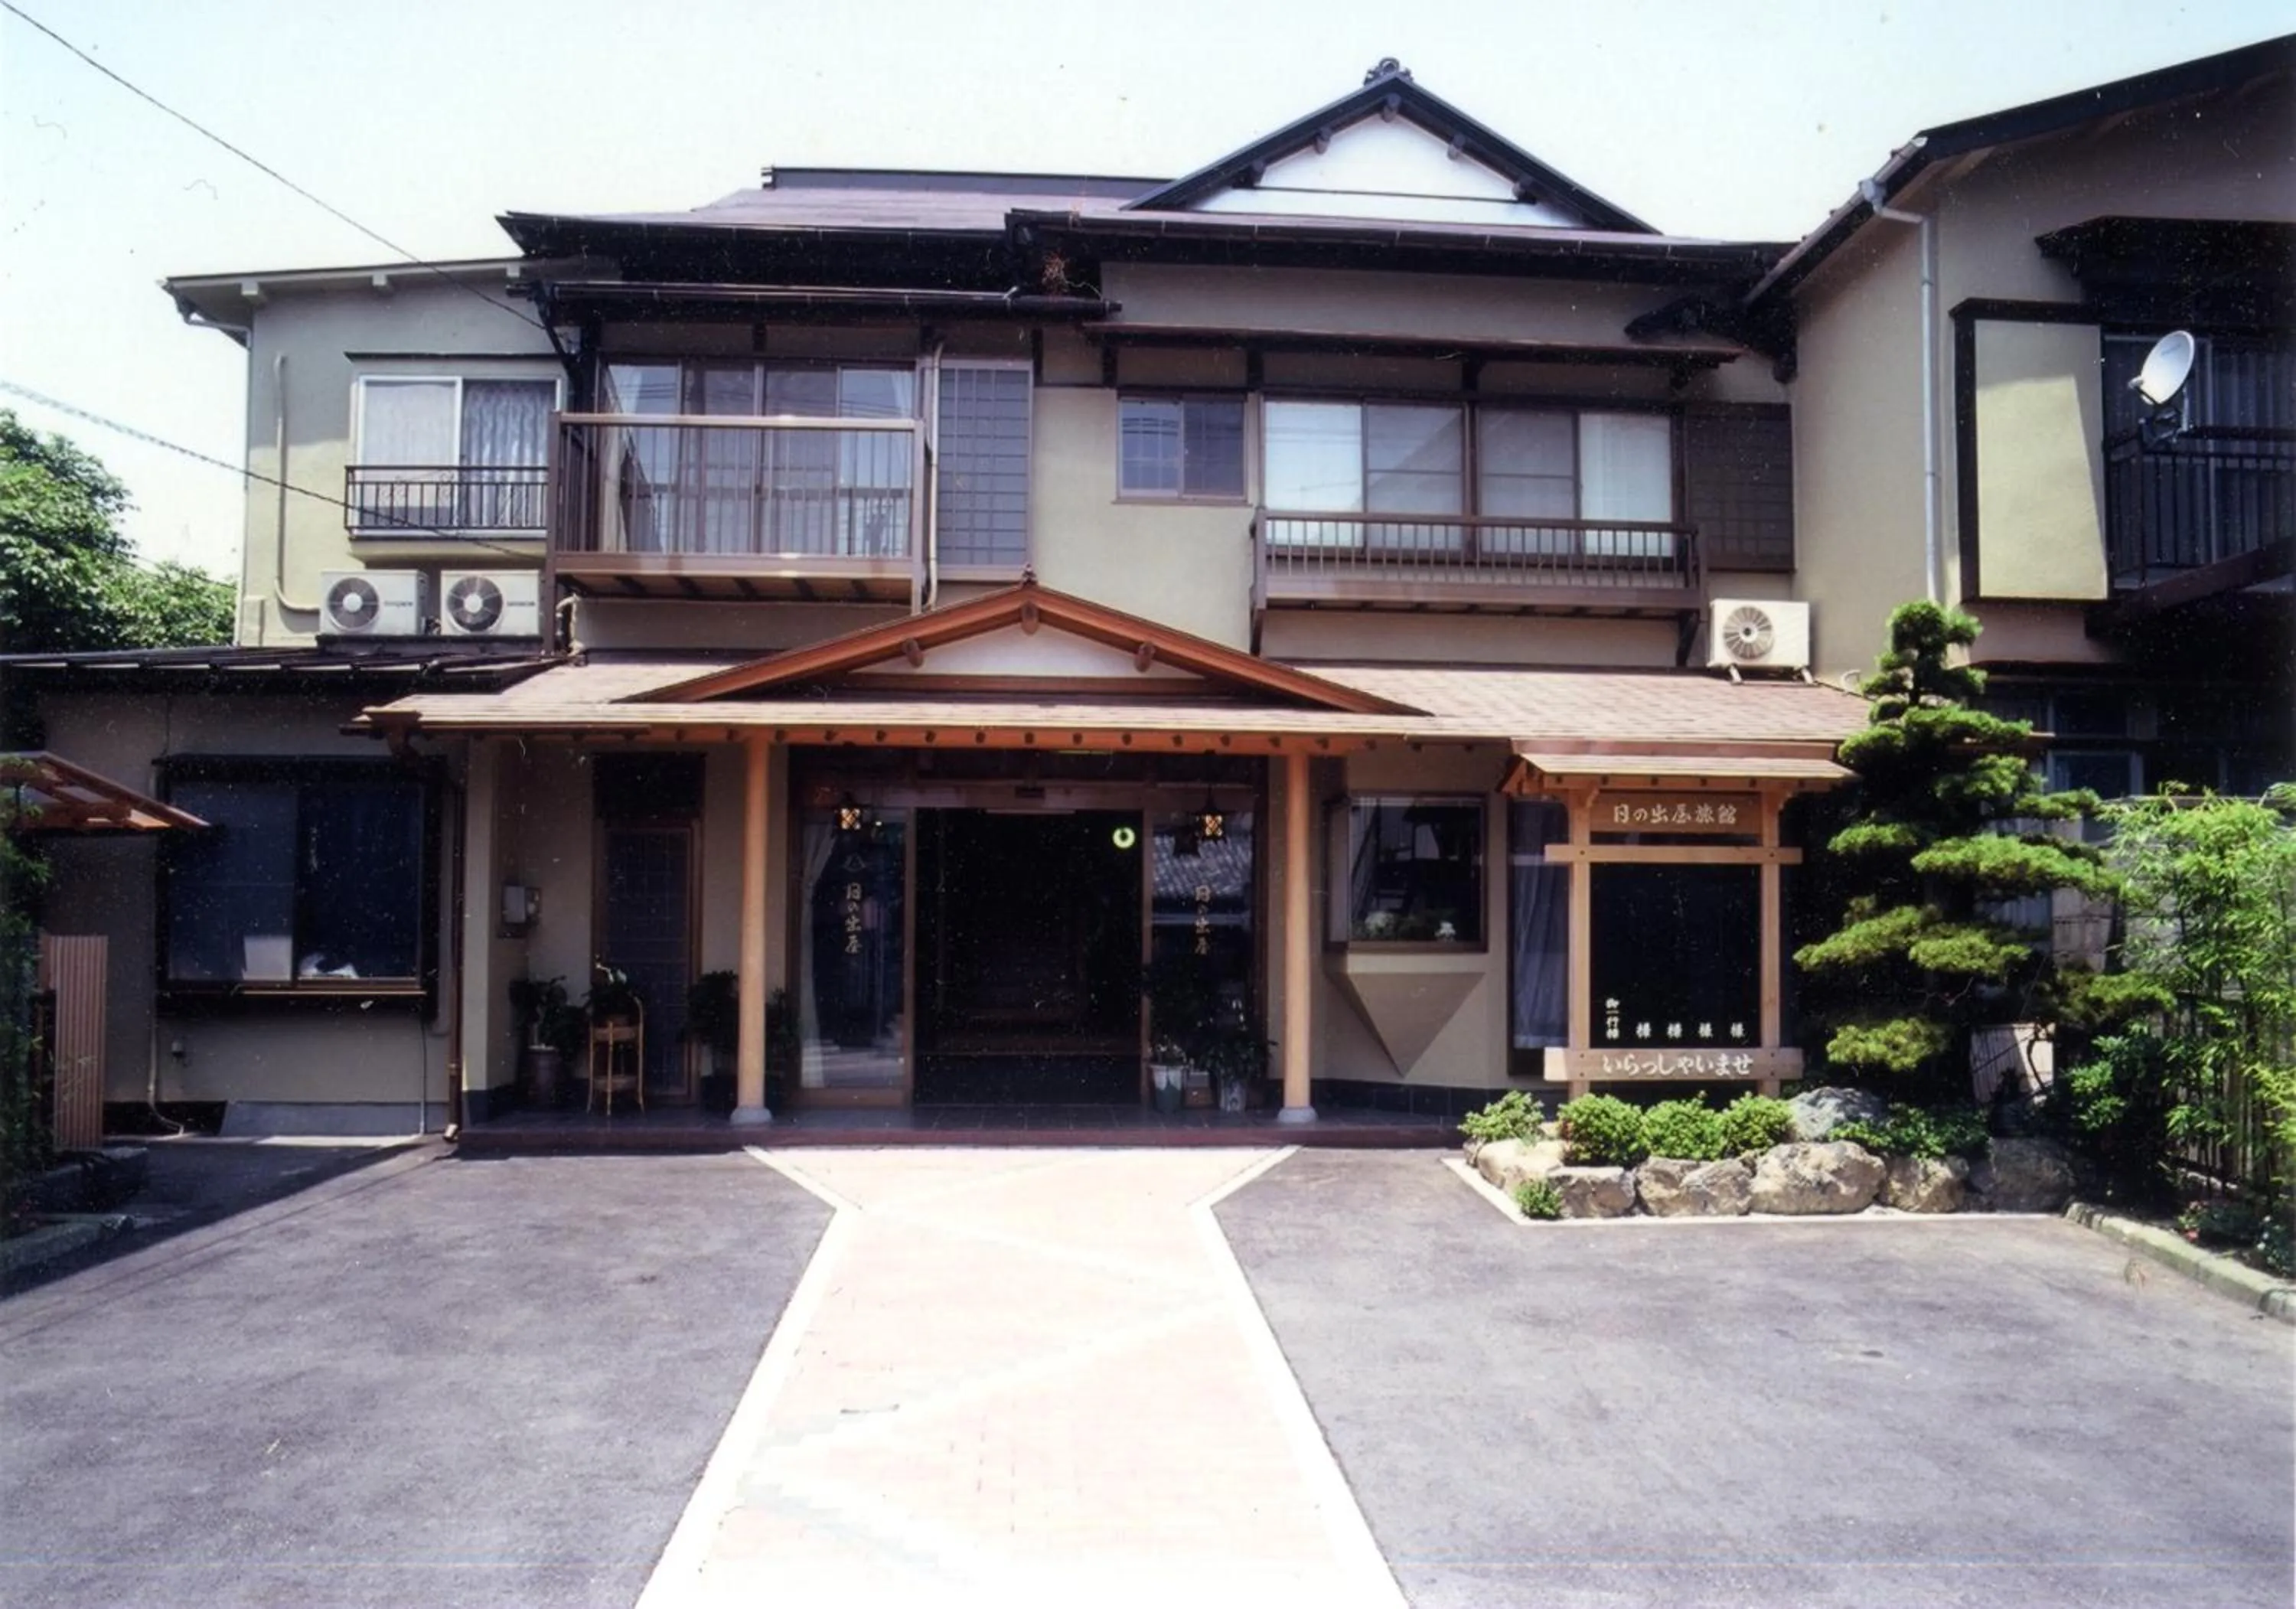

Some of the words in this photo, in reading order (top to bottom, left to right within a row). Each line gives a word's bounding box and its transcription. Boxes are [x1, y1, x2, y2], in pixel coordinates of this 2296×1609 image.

[1613, 802, 1737, 825] 日の出屋旅館
